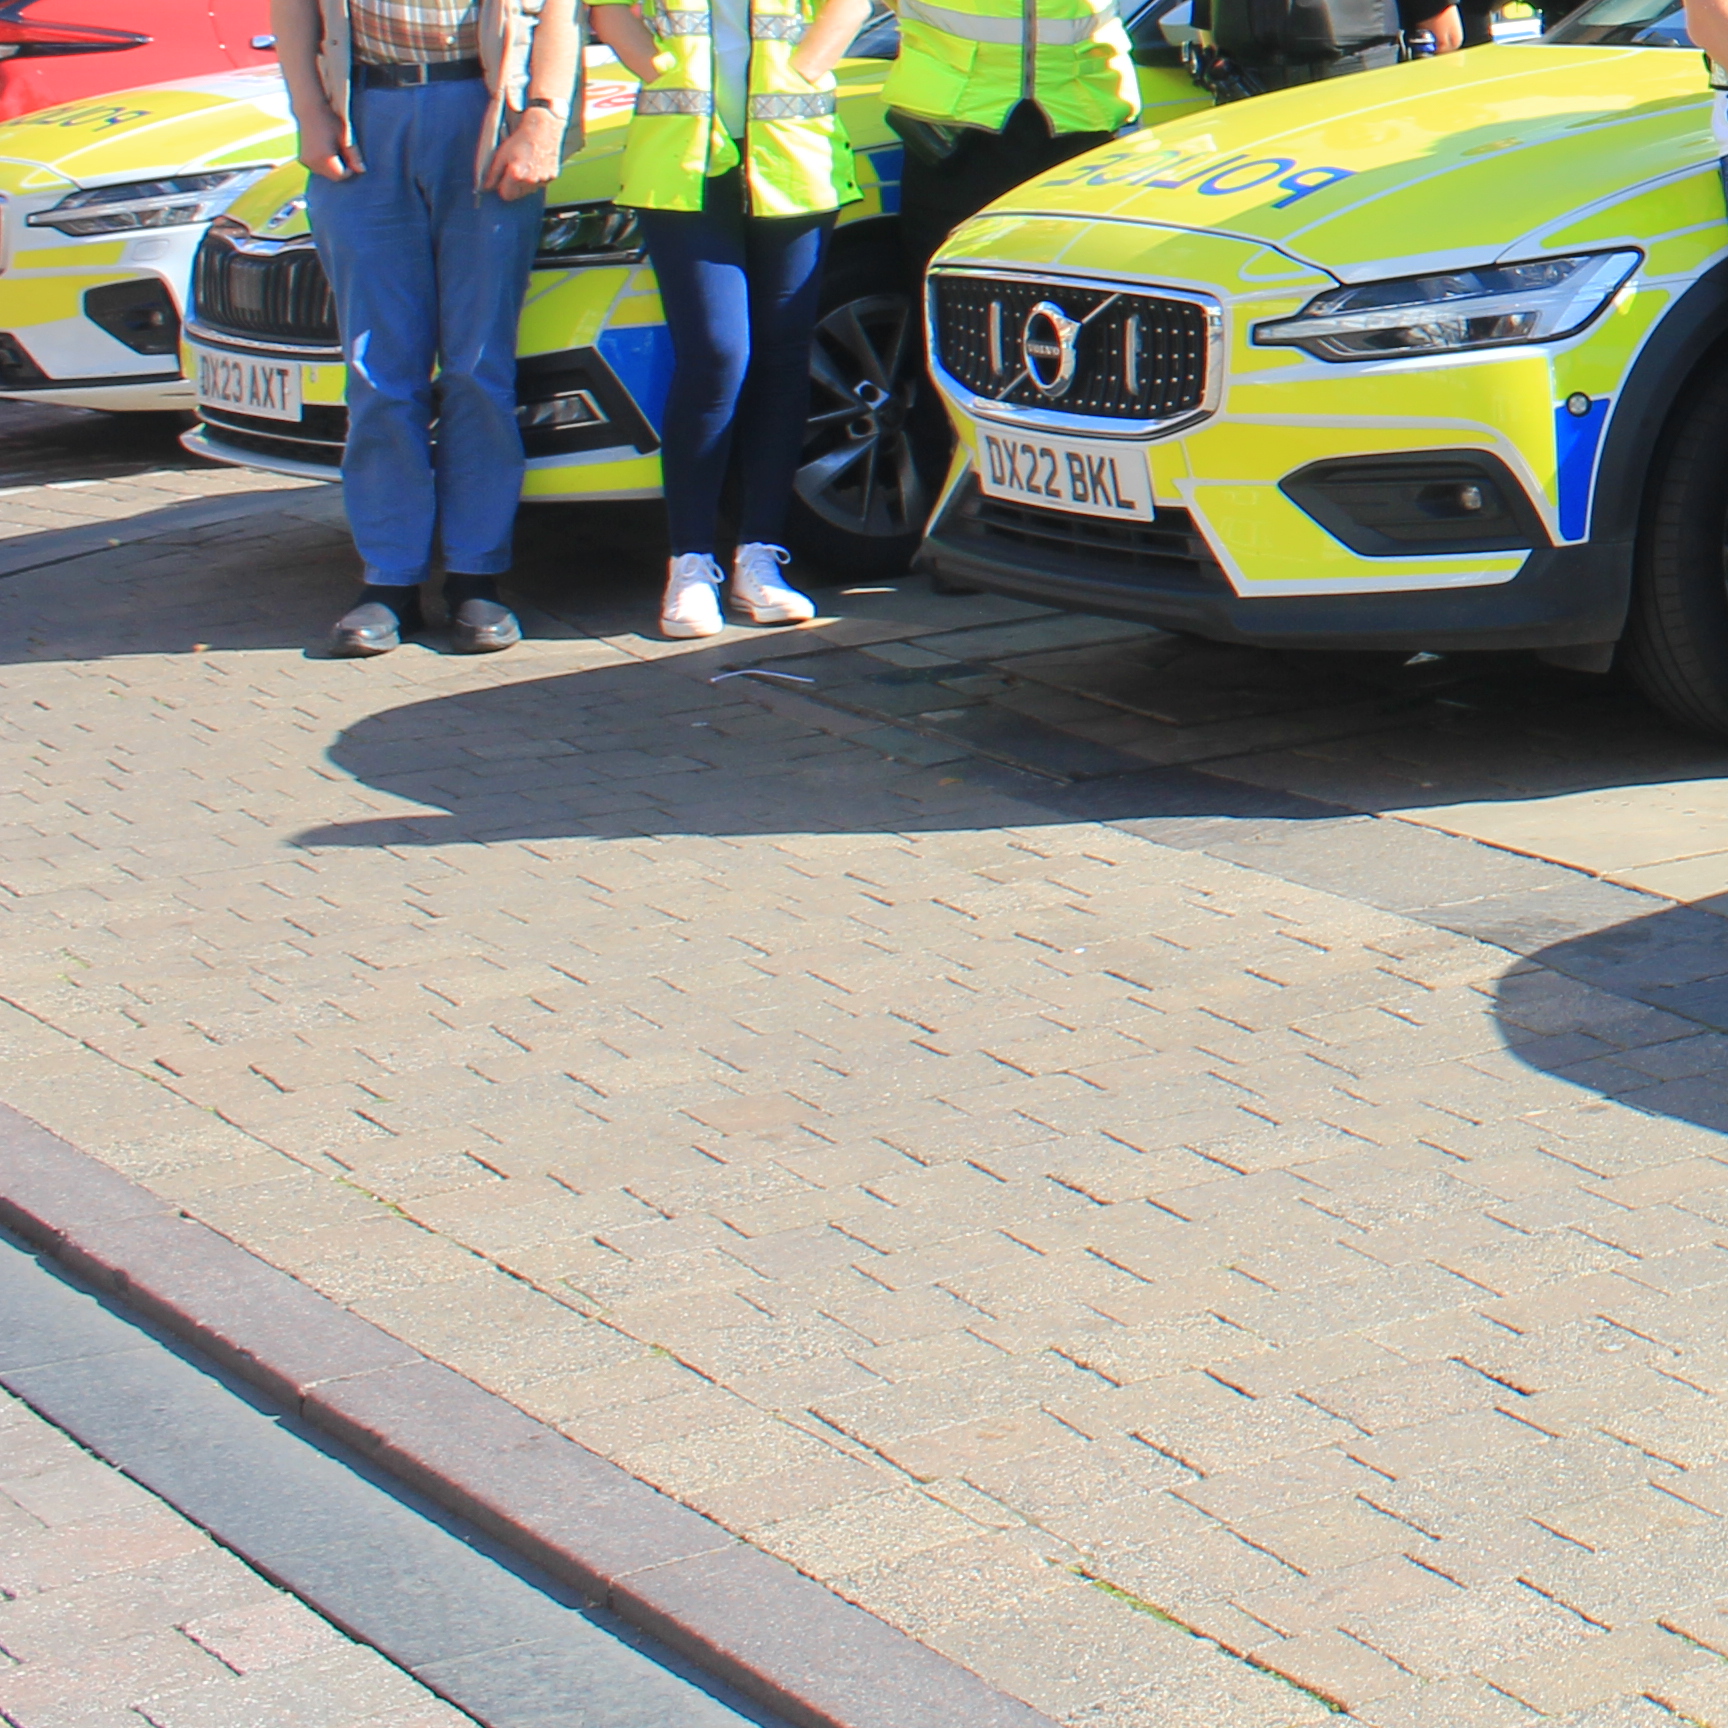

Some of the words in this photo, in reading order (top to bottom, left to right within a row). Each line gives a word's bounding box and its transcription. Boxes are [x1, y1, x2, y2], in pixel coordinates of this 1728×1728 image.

[1027, 343, 1060, 356] VOLVO
[200, 354, 244, 403] DX23
[249, 364, 290, 411] AXT
[985, 435, 1062, 499] DX22
[1065, 451, 1138, 511] BKL
